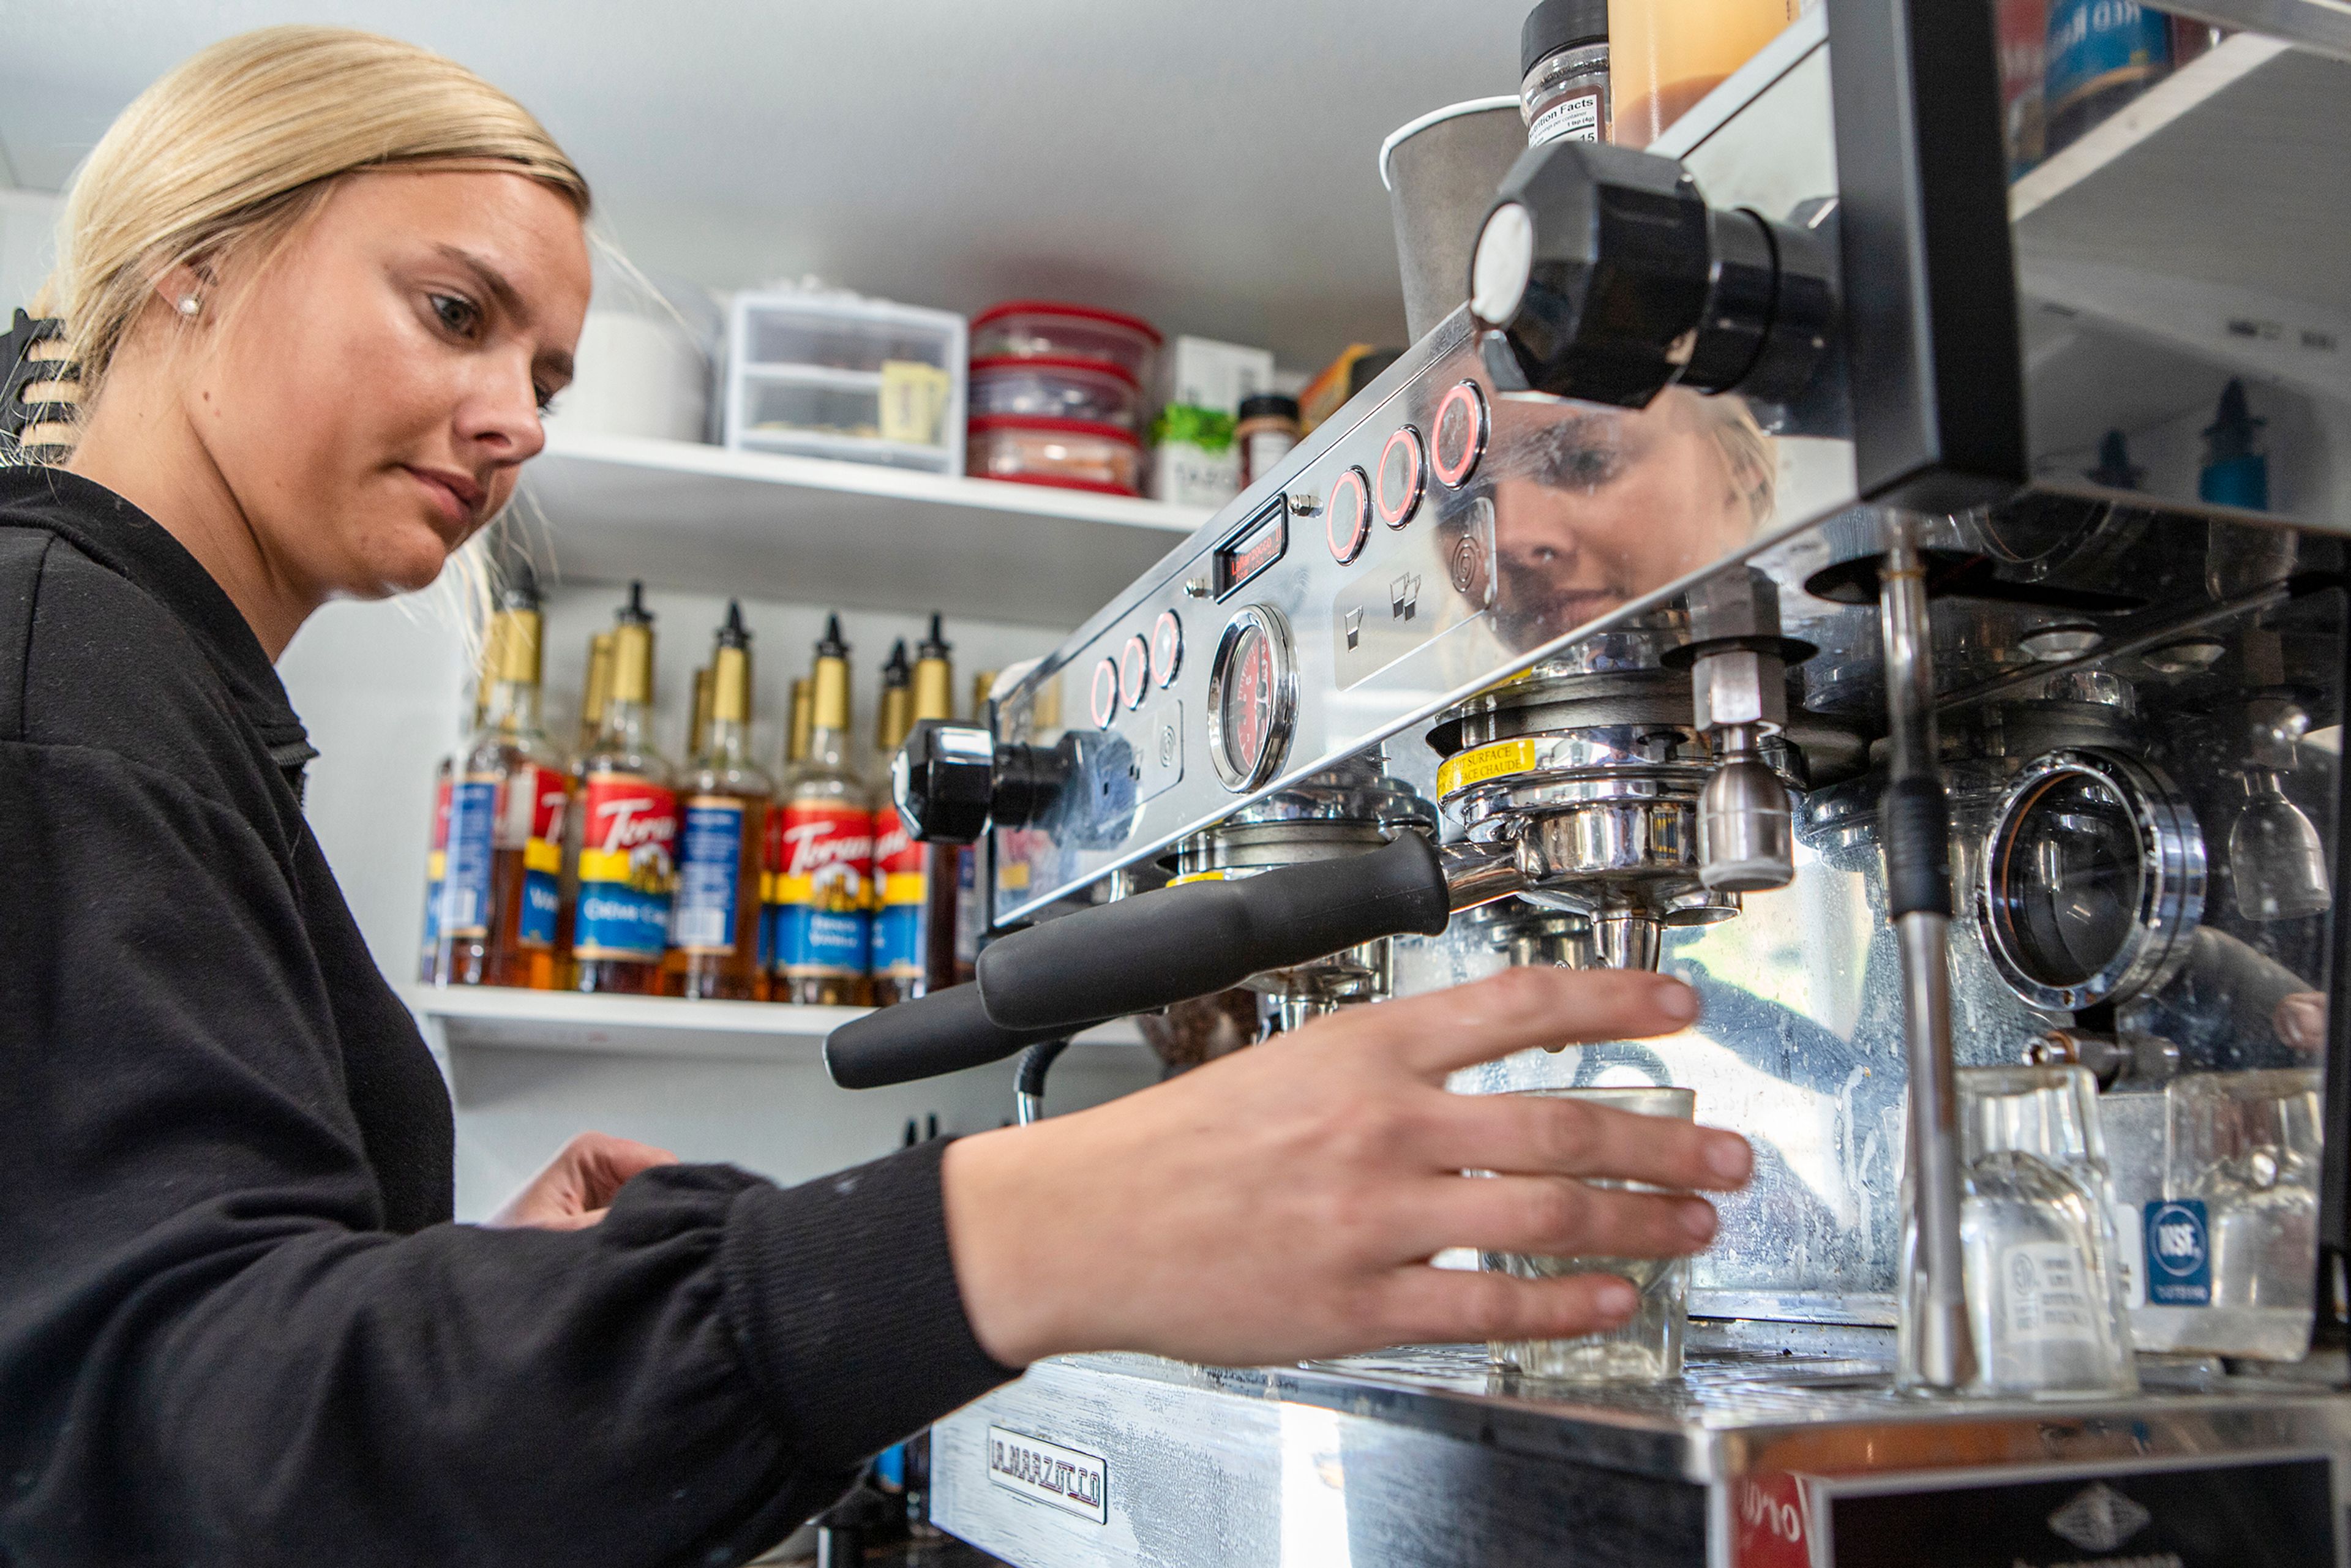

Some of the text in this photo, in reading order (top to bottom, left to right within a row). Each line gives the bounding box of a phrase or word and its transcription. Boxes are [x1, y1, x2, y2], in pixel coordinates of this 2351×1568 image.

[1561, 99, 1593, 114] Facts
[1580, 132, 1594, 142] 15
[1466, 746, 1512, 765] SURFACE
[1480, 759, 1521, 776] CHAUDE
[2159, 1223, 2196, 1257] NSF
